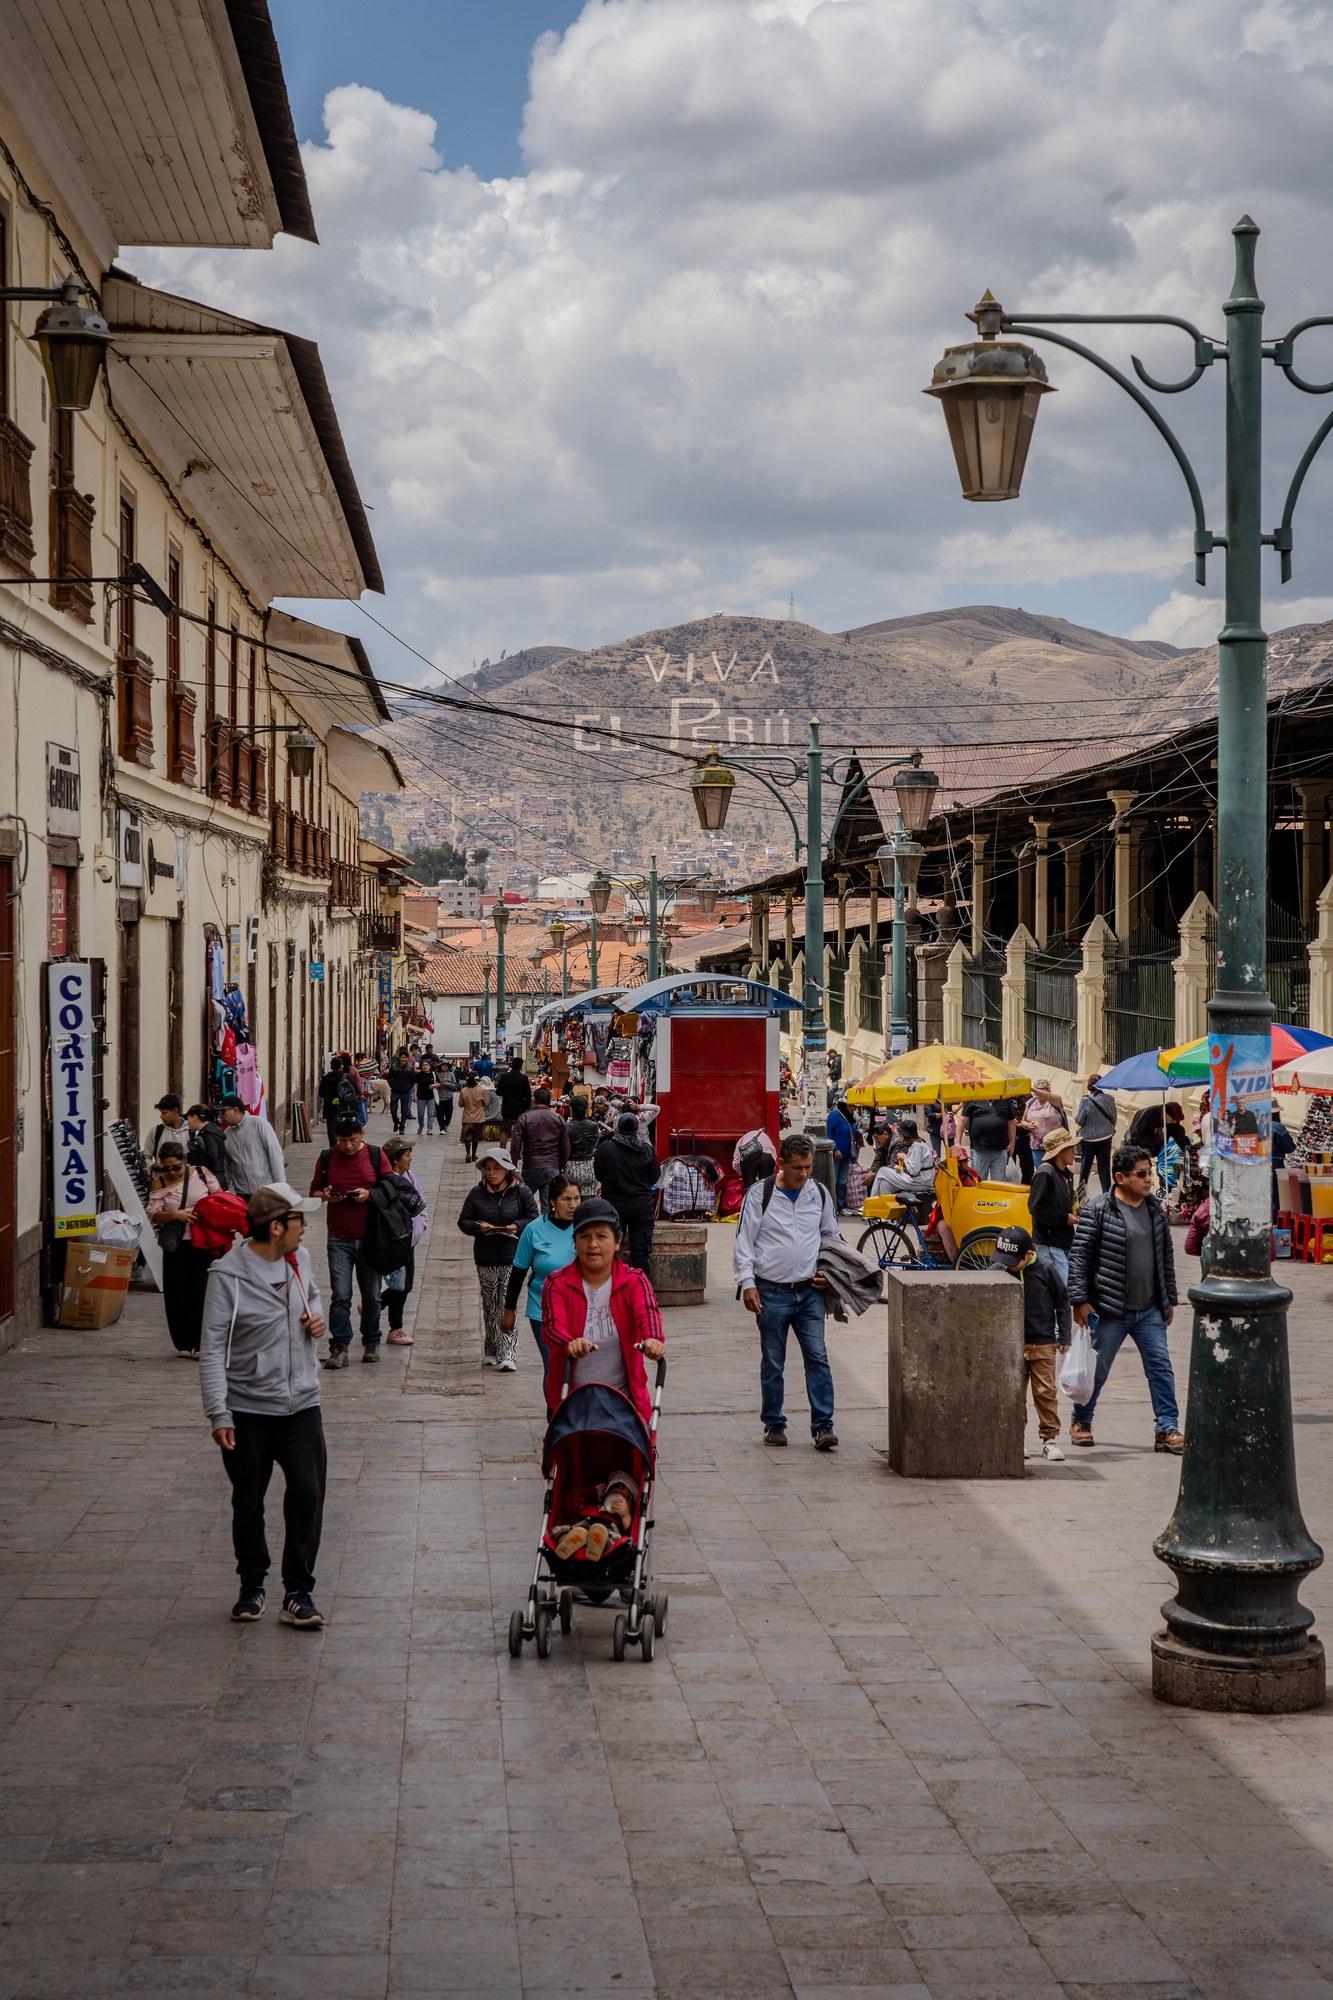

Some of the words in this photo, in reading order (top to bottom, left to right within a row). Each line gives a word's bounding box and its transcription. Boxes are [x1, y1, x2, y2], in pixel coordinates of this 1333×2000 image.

[644, 651, 780, 683] VIVA
[574, 714, 640, 751] EL
[1231, 1069, 1257, 1077] Festival
[59, 974, 88, 1204] CORTINAS
[1237, 1136, 1257, 1147] MIKE
[997, 1236, 1019, 1252] BEATLES
